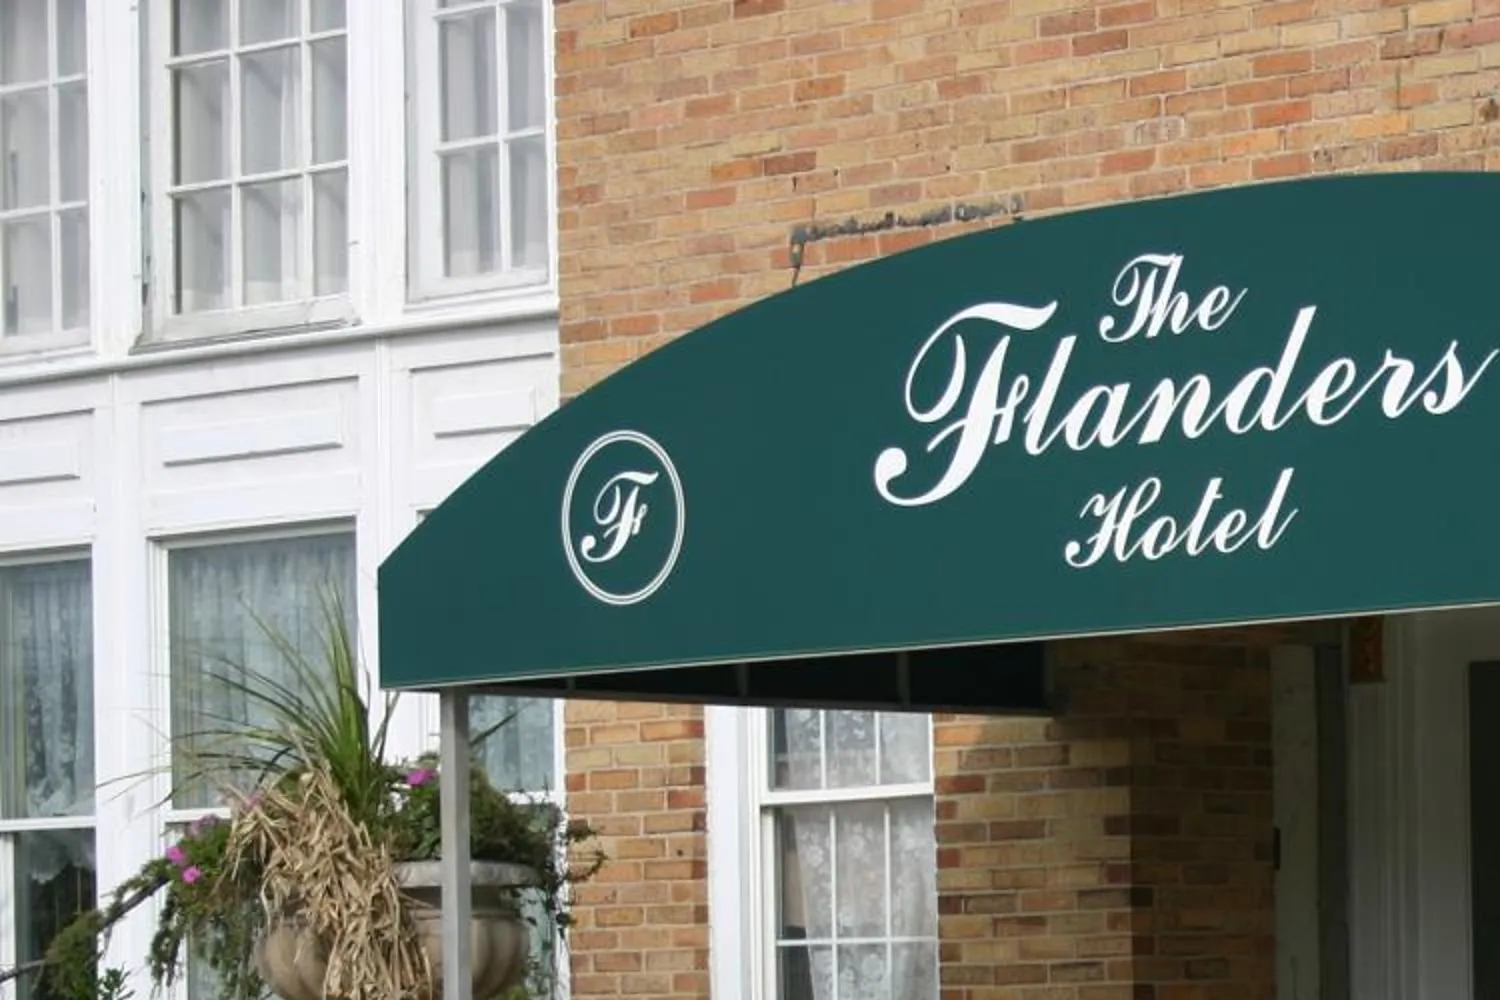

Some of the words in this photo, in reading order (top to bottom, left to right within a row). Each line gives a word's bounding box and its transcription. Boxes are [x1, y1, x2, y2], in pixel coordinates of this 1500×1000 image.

[1099, 253, 1247, 342] The
[874, 304, 1499, 506] Flanders
[581, 471, 658, 562] F
[1065, 468, 1297, 567] Hotel
